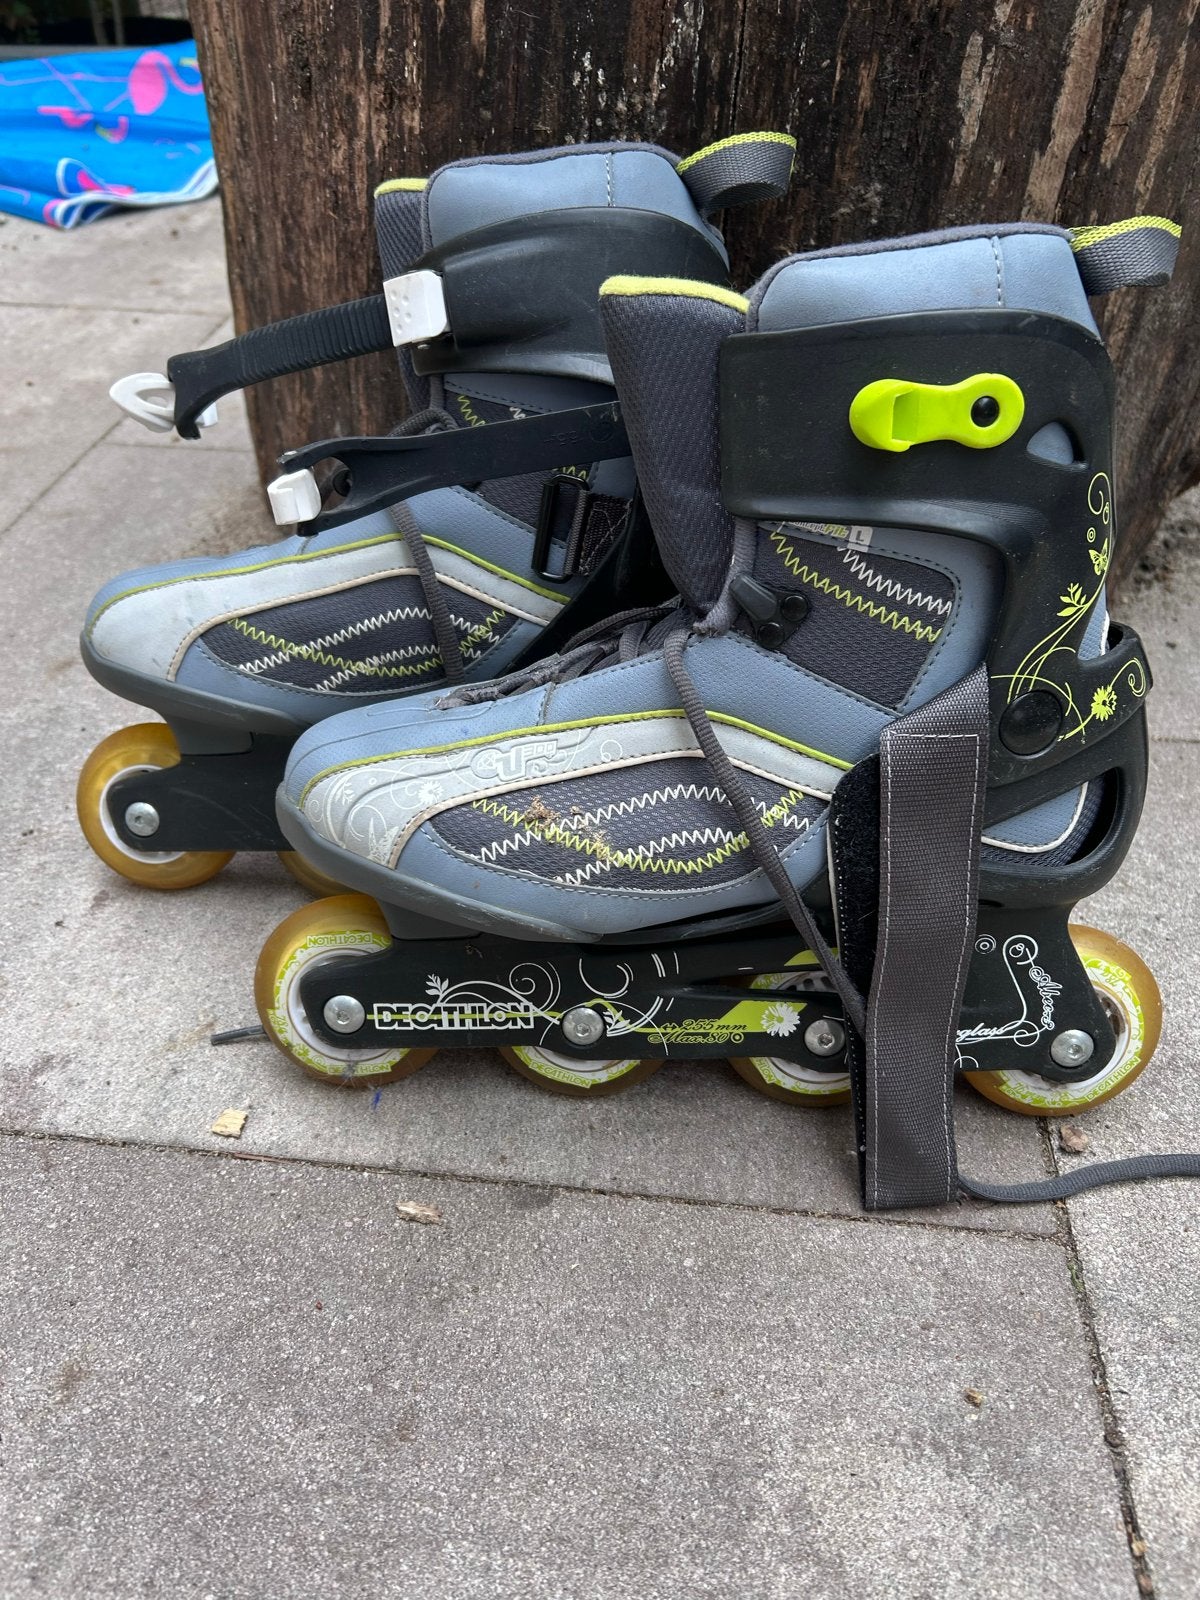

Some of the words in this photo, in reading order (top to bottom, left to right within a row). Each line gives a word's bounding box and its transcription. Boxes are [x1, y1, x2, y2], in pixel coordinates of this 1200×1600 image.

[306, 932, 373, 947] DECATHLON
[373, 1002, 535, 1031] DECATHLON
[682, 1019, 719, 1031] 255
[717, 1023, 748, 1031] mm
[528, 1061, 592, 1089] DECATHLON
[1086, 1056, 1141, 1102] DECATHLON
